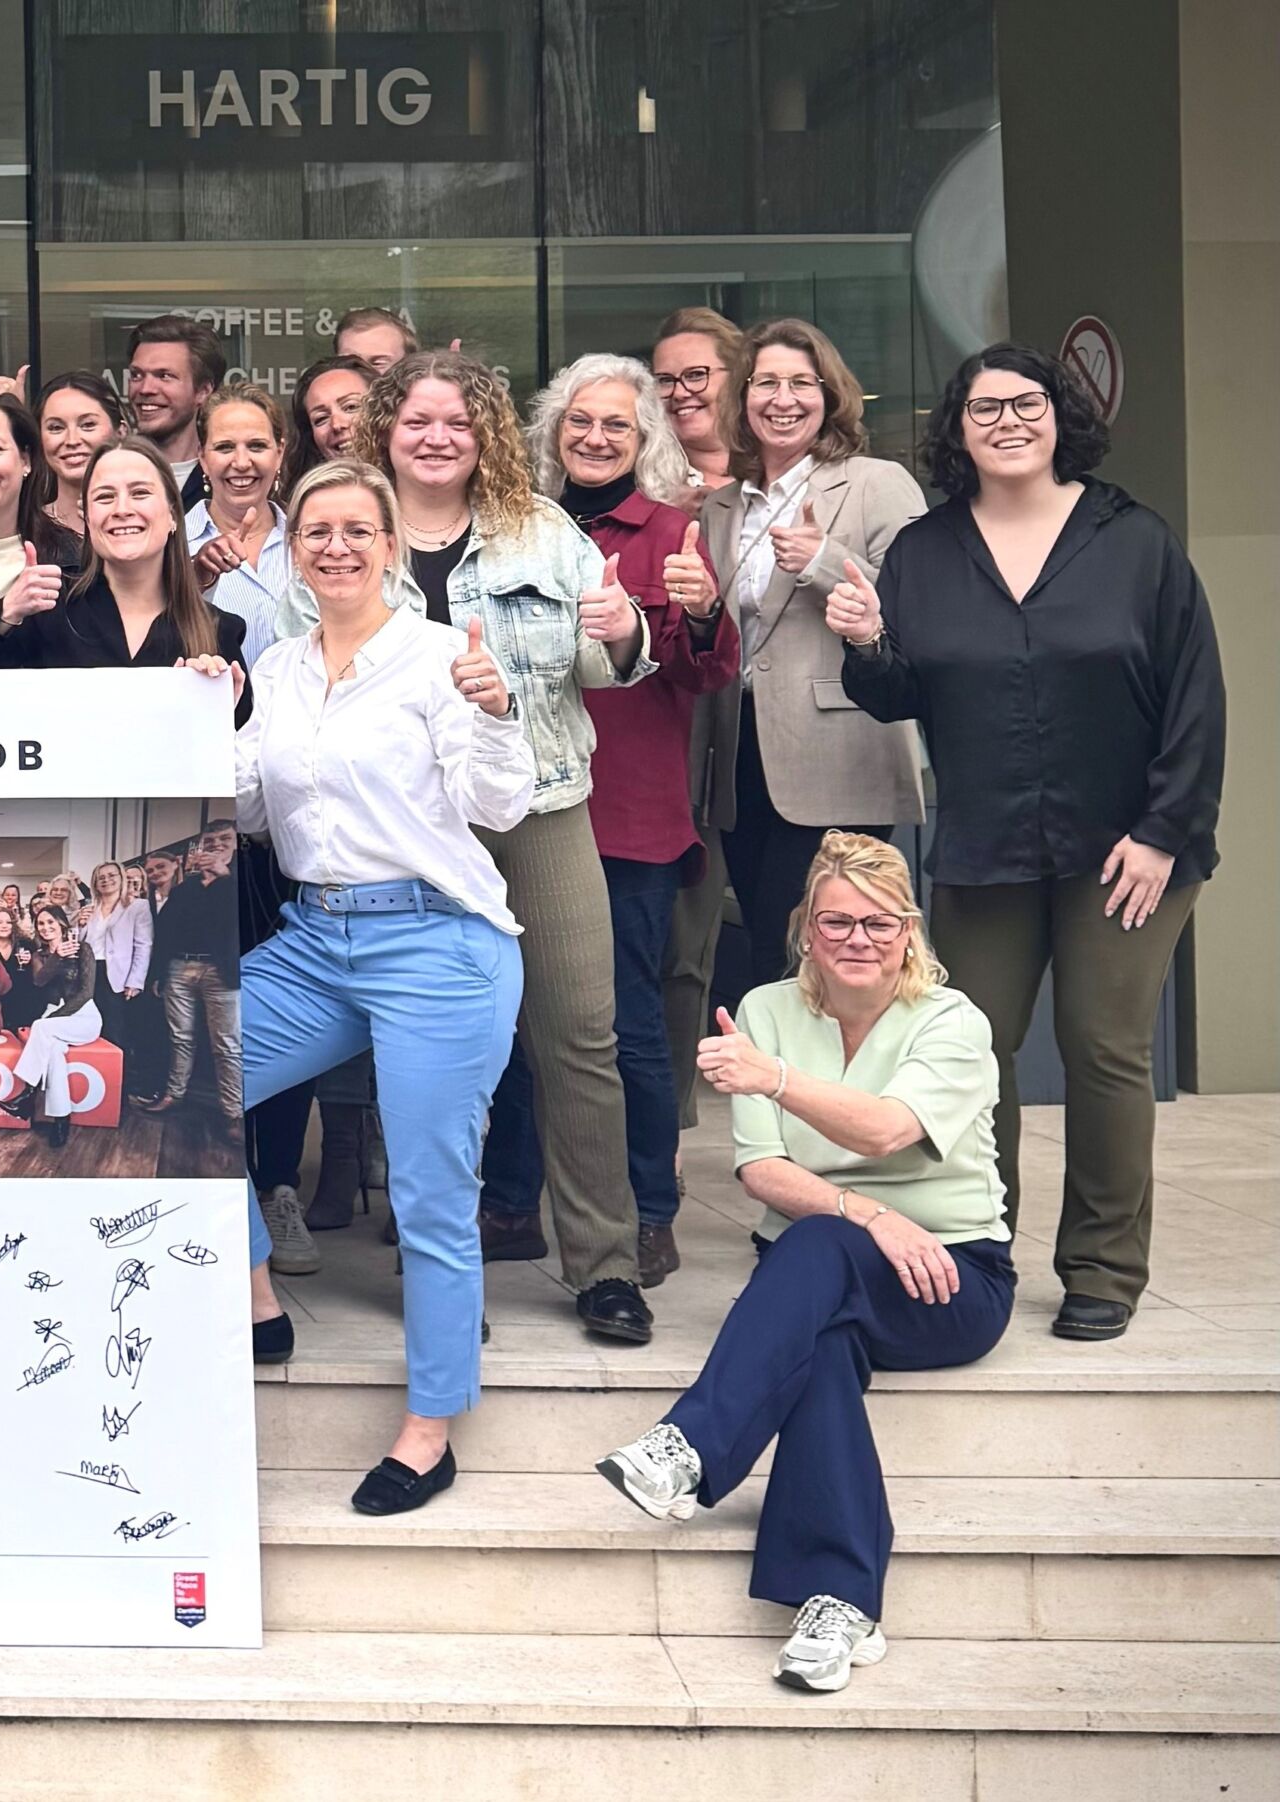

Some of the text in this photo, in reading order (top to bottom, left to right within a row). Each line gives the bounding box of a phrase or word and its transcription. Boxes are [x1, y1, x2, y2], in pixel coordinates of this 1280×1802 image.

[148, 67, 432, 127] HARTIG
[170, 307, 304, 337] OFFEE
[18, 740, 43, 771] B
